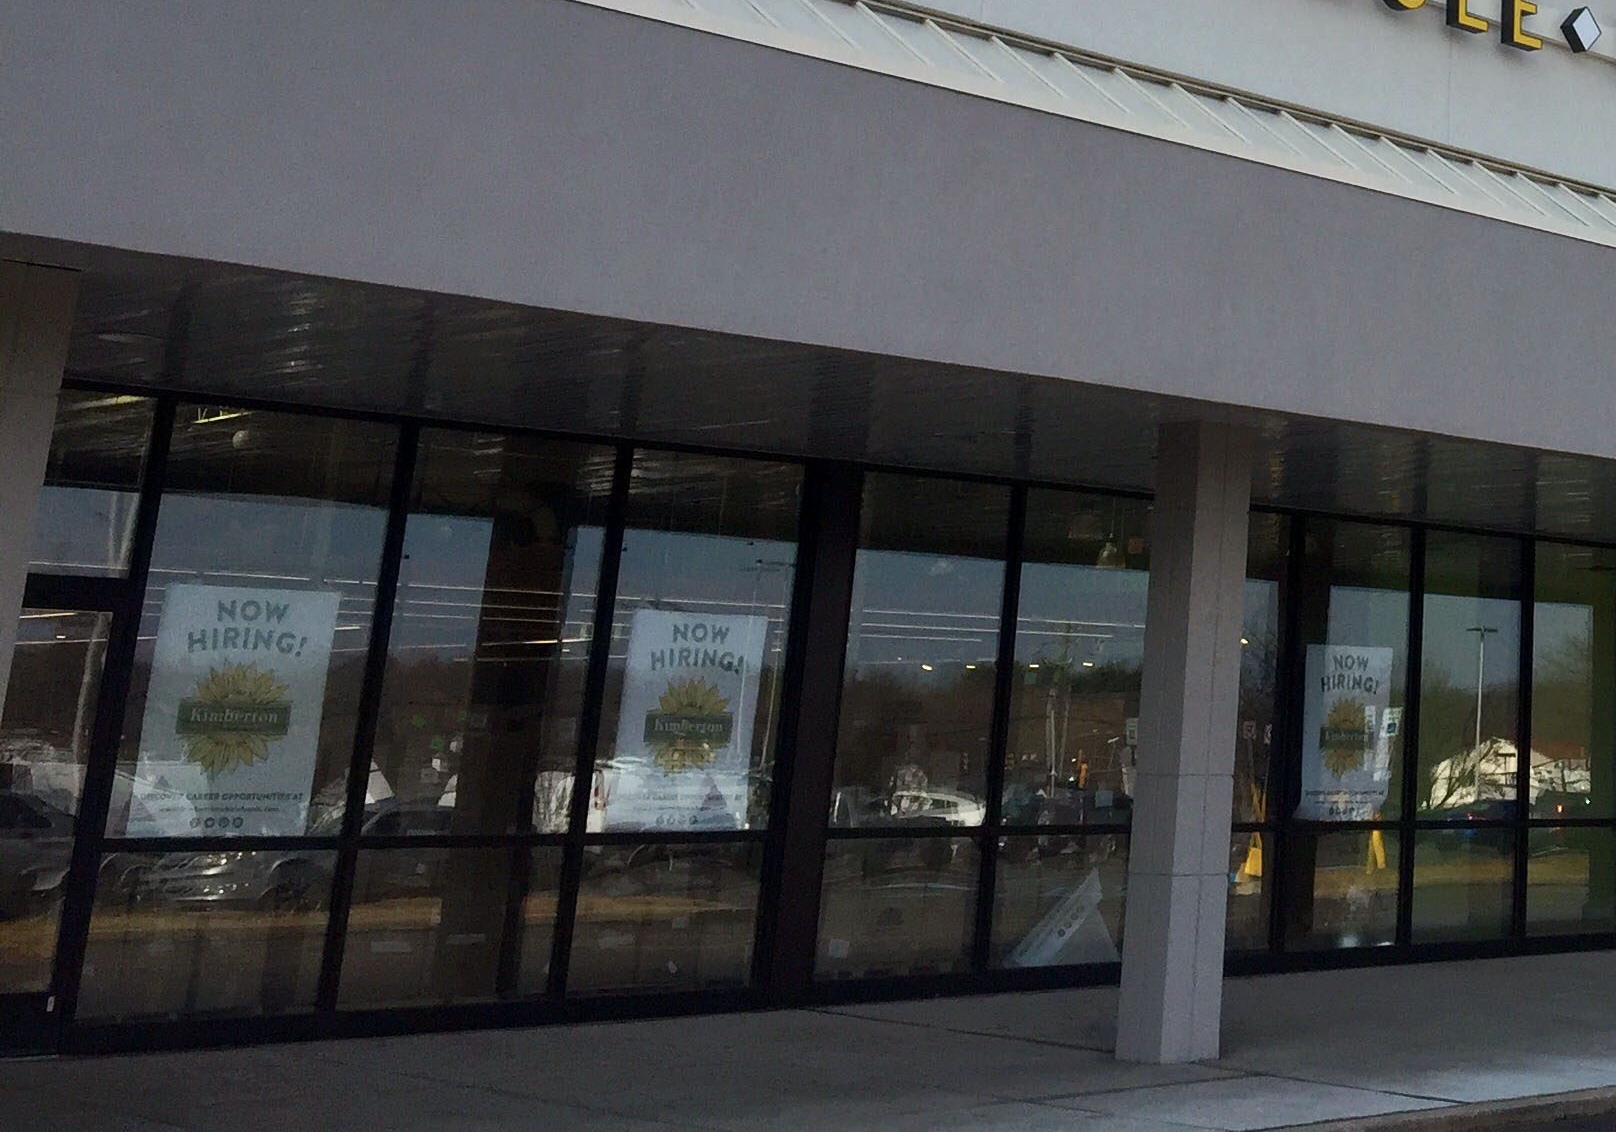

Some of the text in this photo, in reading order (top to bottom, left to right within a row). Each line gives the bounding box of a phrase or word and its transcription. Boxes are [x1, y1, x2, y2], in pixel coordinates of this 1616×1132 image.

[216, 599, 290, 625] NOW
[187, 627, 308, 658] HIRING!
[672, 623, 730, 645] NOW
[650, 648, 745, 675] HIRING!
[1332, 654, 1369, 671] NOW
[1321, 674, 1380, 696] HIRING!
[190, 706, 279, 725] Kimberton
